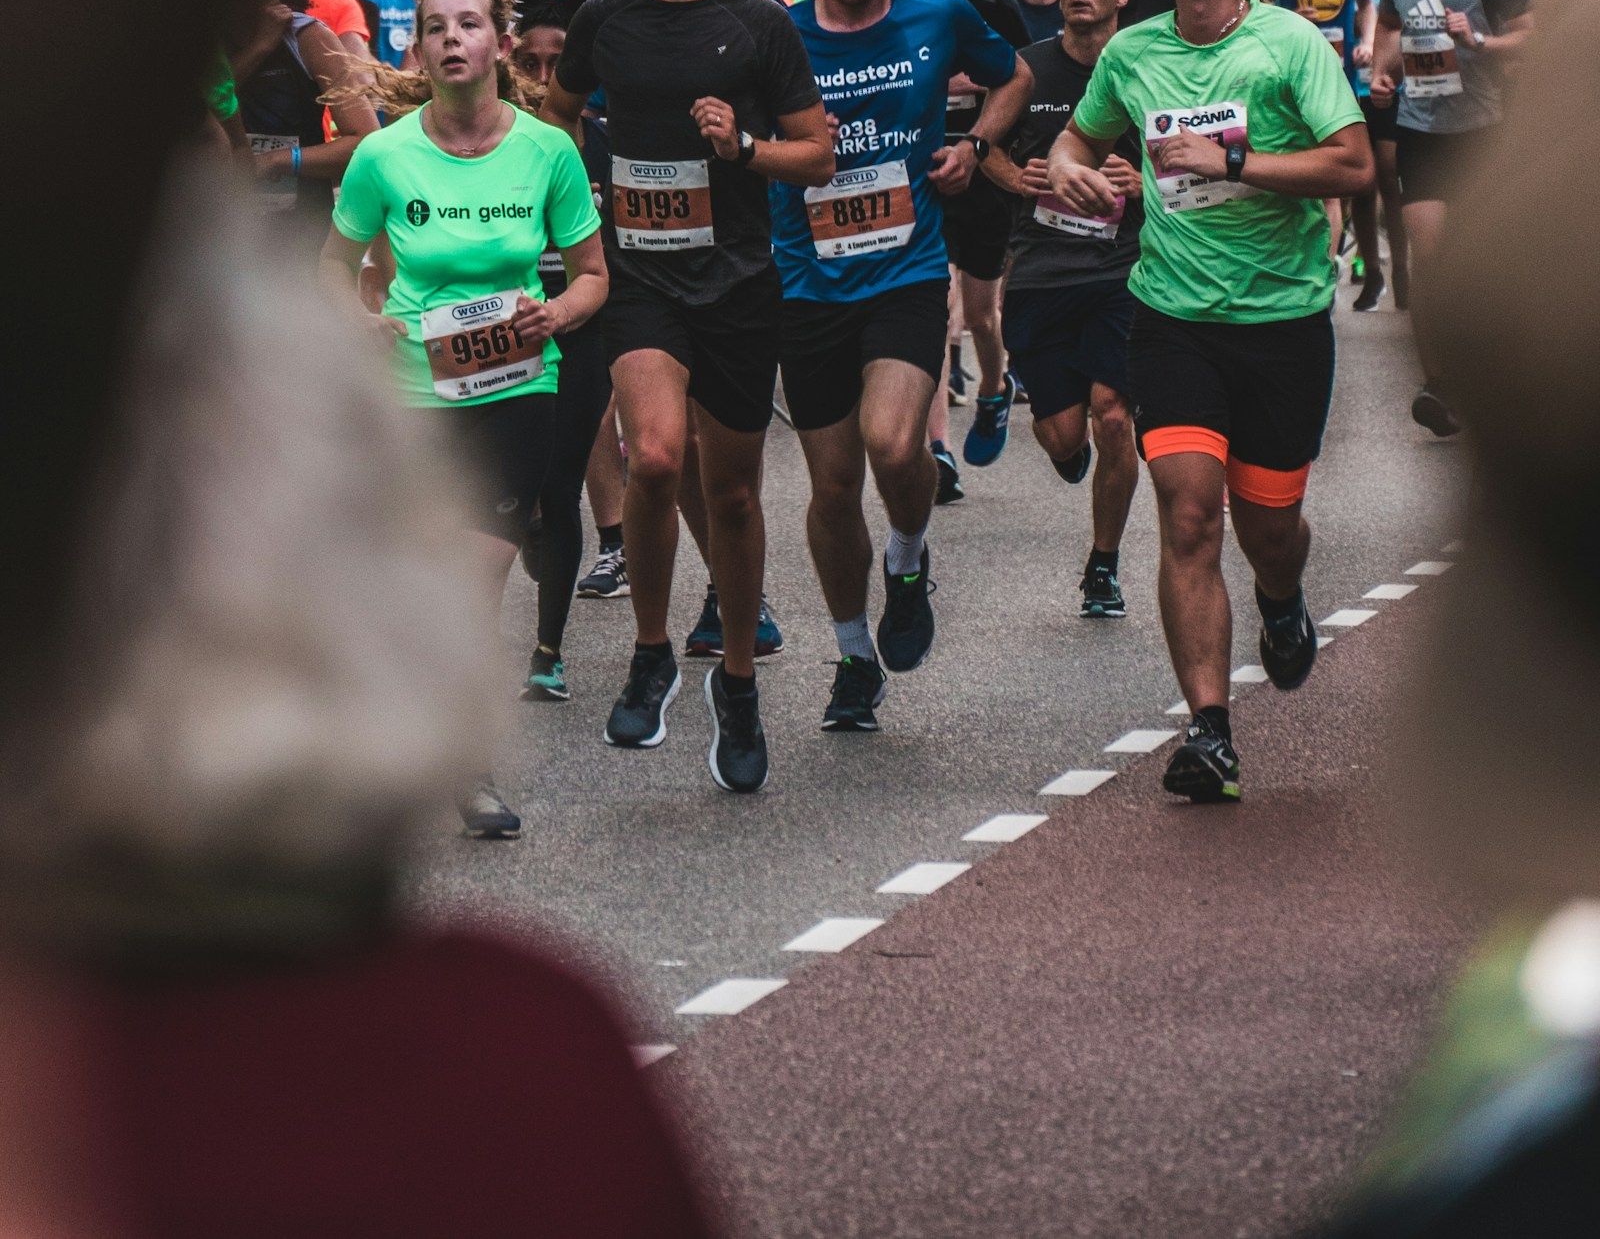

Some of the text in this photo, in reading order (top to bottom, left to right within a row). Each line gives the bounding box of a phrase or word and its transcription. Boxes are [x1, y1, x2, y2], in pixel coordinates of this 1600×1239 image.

[1404, 15, 1447, 29] adida
[1178, 109, 1237, 128] SCANIA
[634, 165, 671, 176] wavin
[835, 170, 873, 185] wavin
[626, 189, 691, 219] 9193
[1196, 195, 1209, 204] HM
[437, 204, 533, 223] van gelder
[832, 191, 891, 227] 8877
[457, 299, 499, 317] wavin
[451, 324, 524, 365] 9561
